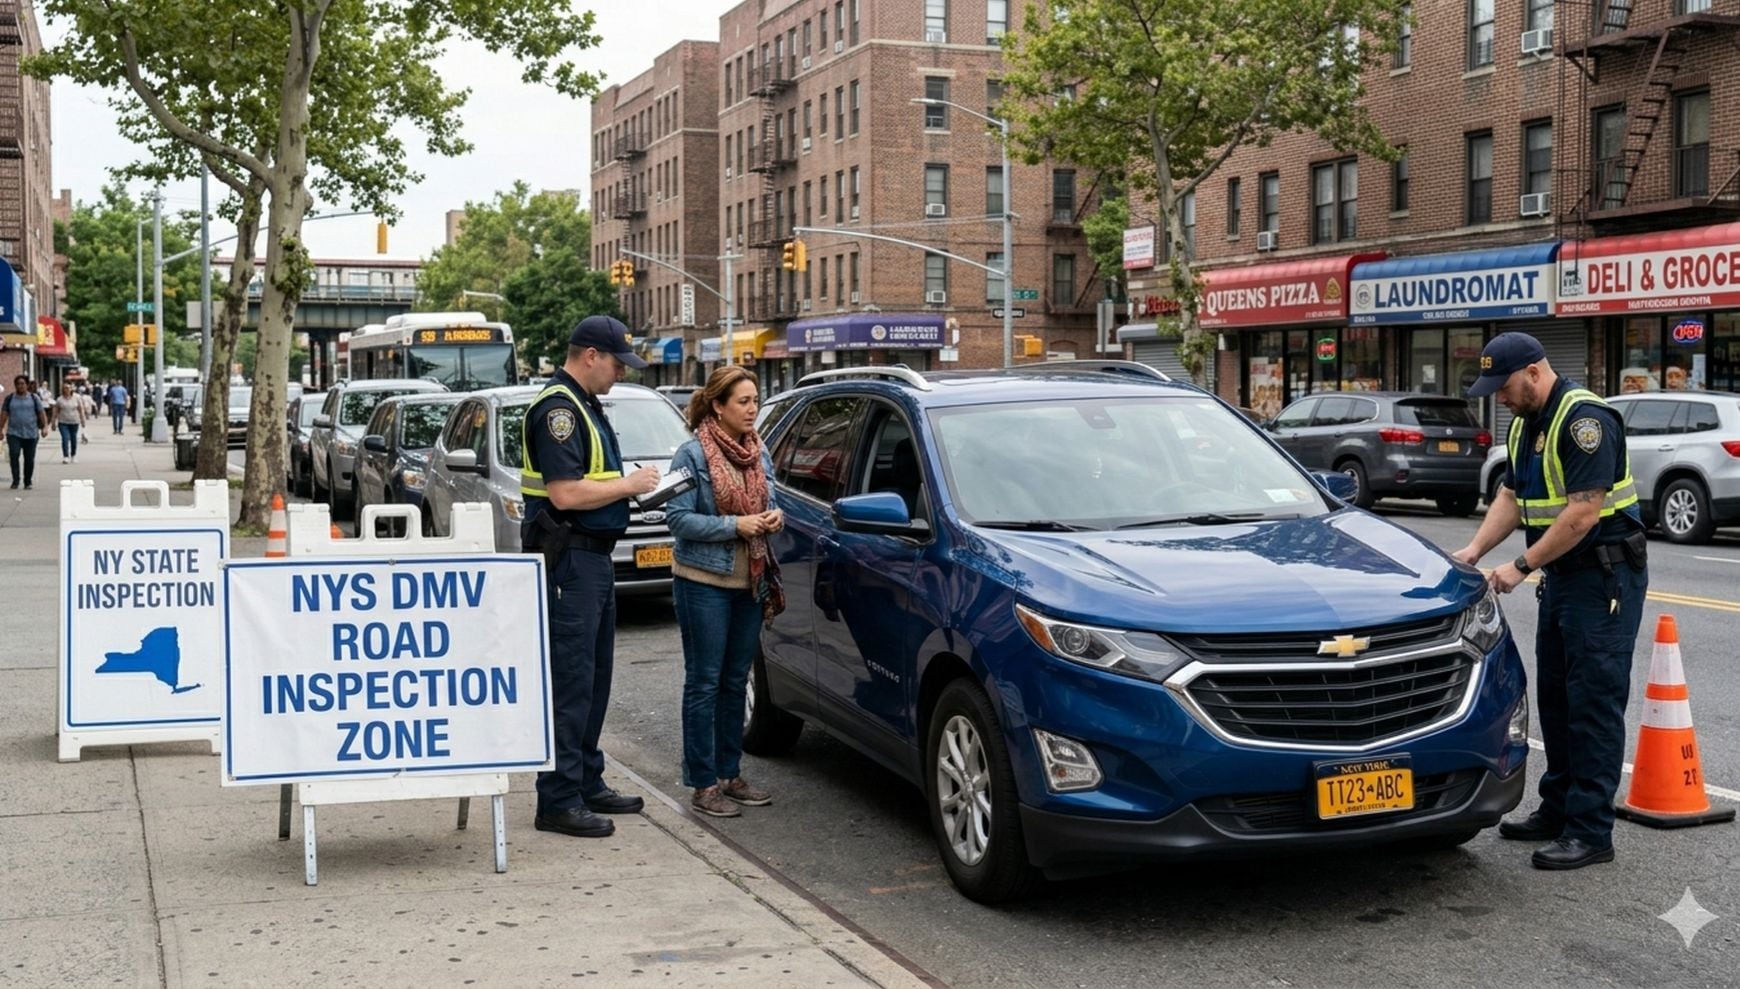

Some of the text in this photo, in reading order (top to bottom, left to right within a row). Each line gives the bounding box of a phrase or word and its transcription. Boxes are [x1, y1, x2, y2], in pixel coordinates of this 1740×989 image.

[1374, 270, 1539, 309] LAUNDROMAT
[1587, 260, 1633, 294] DELI
[1640, 258, 1655, 291] &
[1663, 251, 1740, 290] GROCE
[1206, 286, 1267, 316] QUEENS
[1270, 281, 1320, 308] PIZZA
[94, 548, 199, 575] NY STATE
[78, 581, 214, 609] INSPECTION
[292, 571, 486, 612] NYS DMV
[332, 620, 450, 661] ROAD
[262, 666, 518, 714] INSPECTION
[336, 718, 450, 762] ZONE
